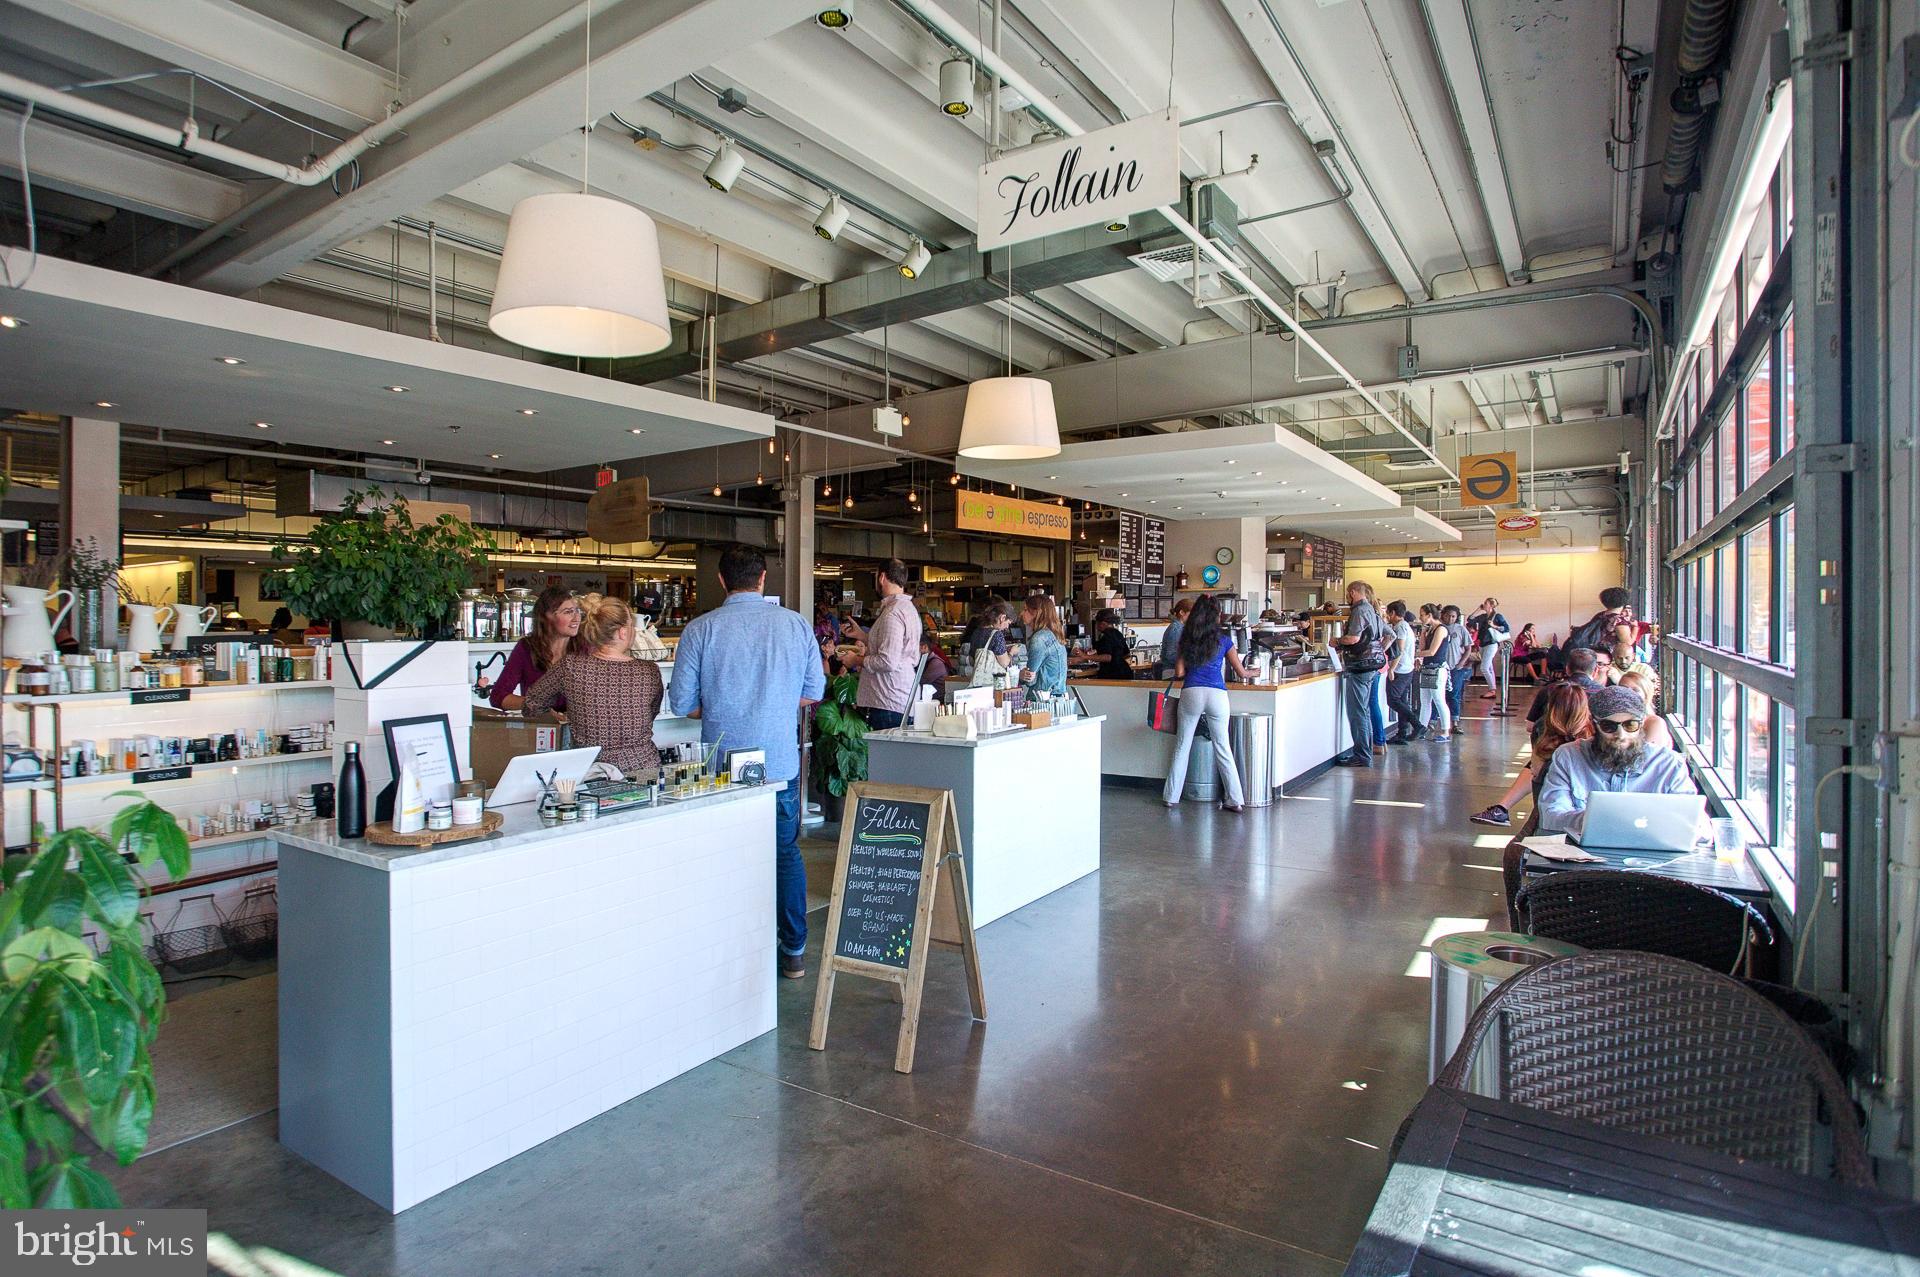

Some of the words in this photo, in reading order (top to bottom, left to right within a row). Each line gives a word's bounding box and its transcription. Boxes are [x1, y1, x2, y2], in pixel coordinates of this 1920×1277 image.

[998, 146, 1143, 235] Follain
[1027, 511, 1069, 529] espresso
[144, 693, 180, 701] CLEANSERS
[148, 771, 179, 780] SERUMS
[862, 804, 920, 831] Follain
[862, 894, 895, 905] COSMETICS
[847, 907, 862, 918] OVER
[864, 907, 873, 919] 40
[862, 921, 890, 934] BRANDS
